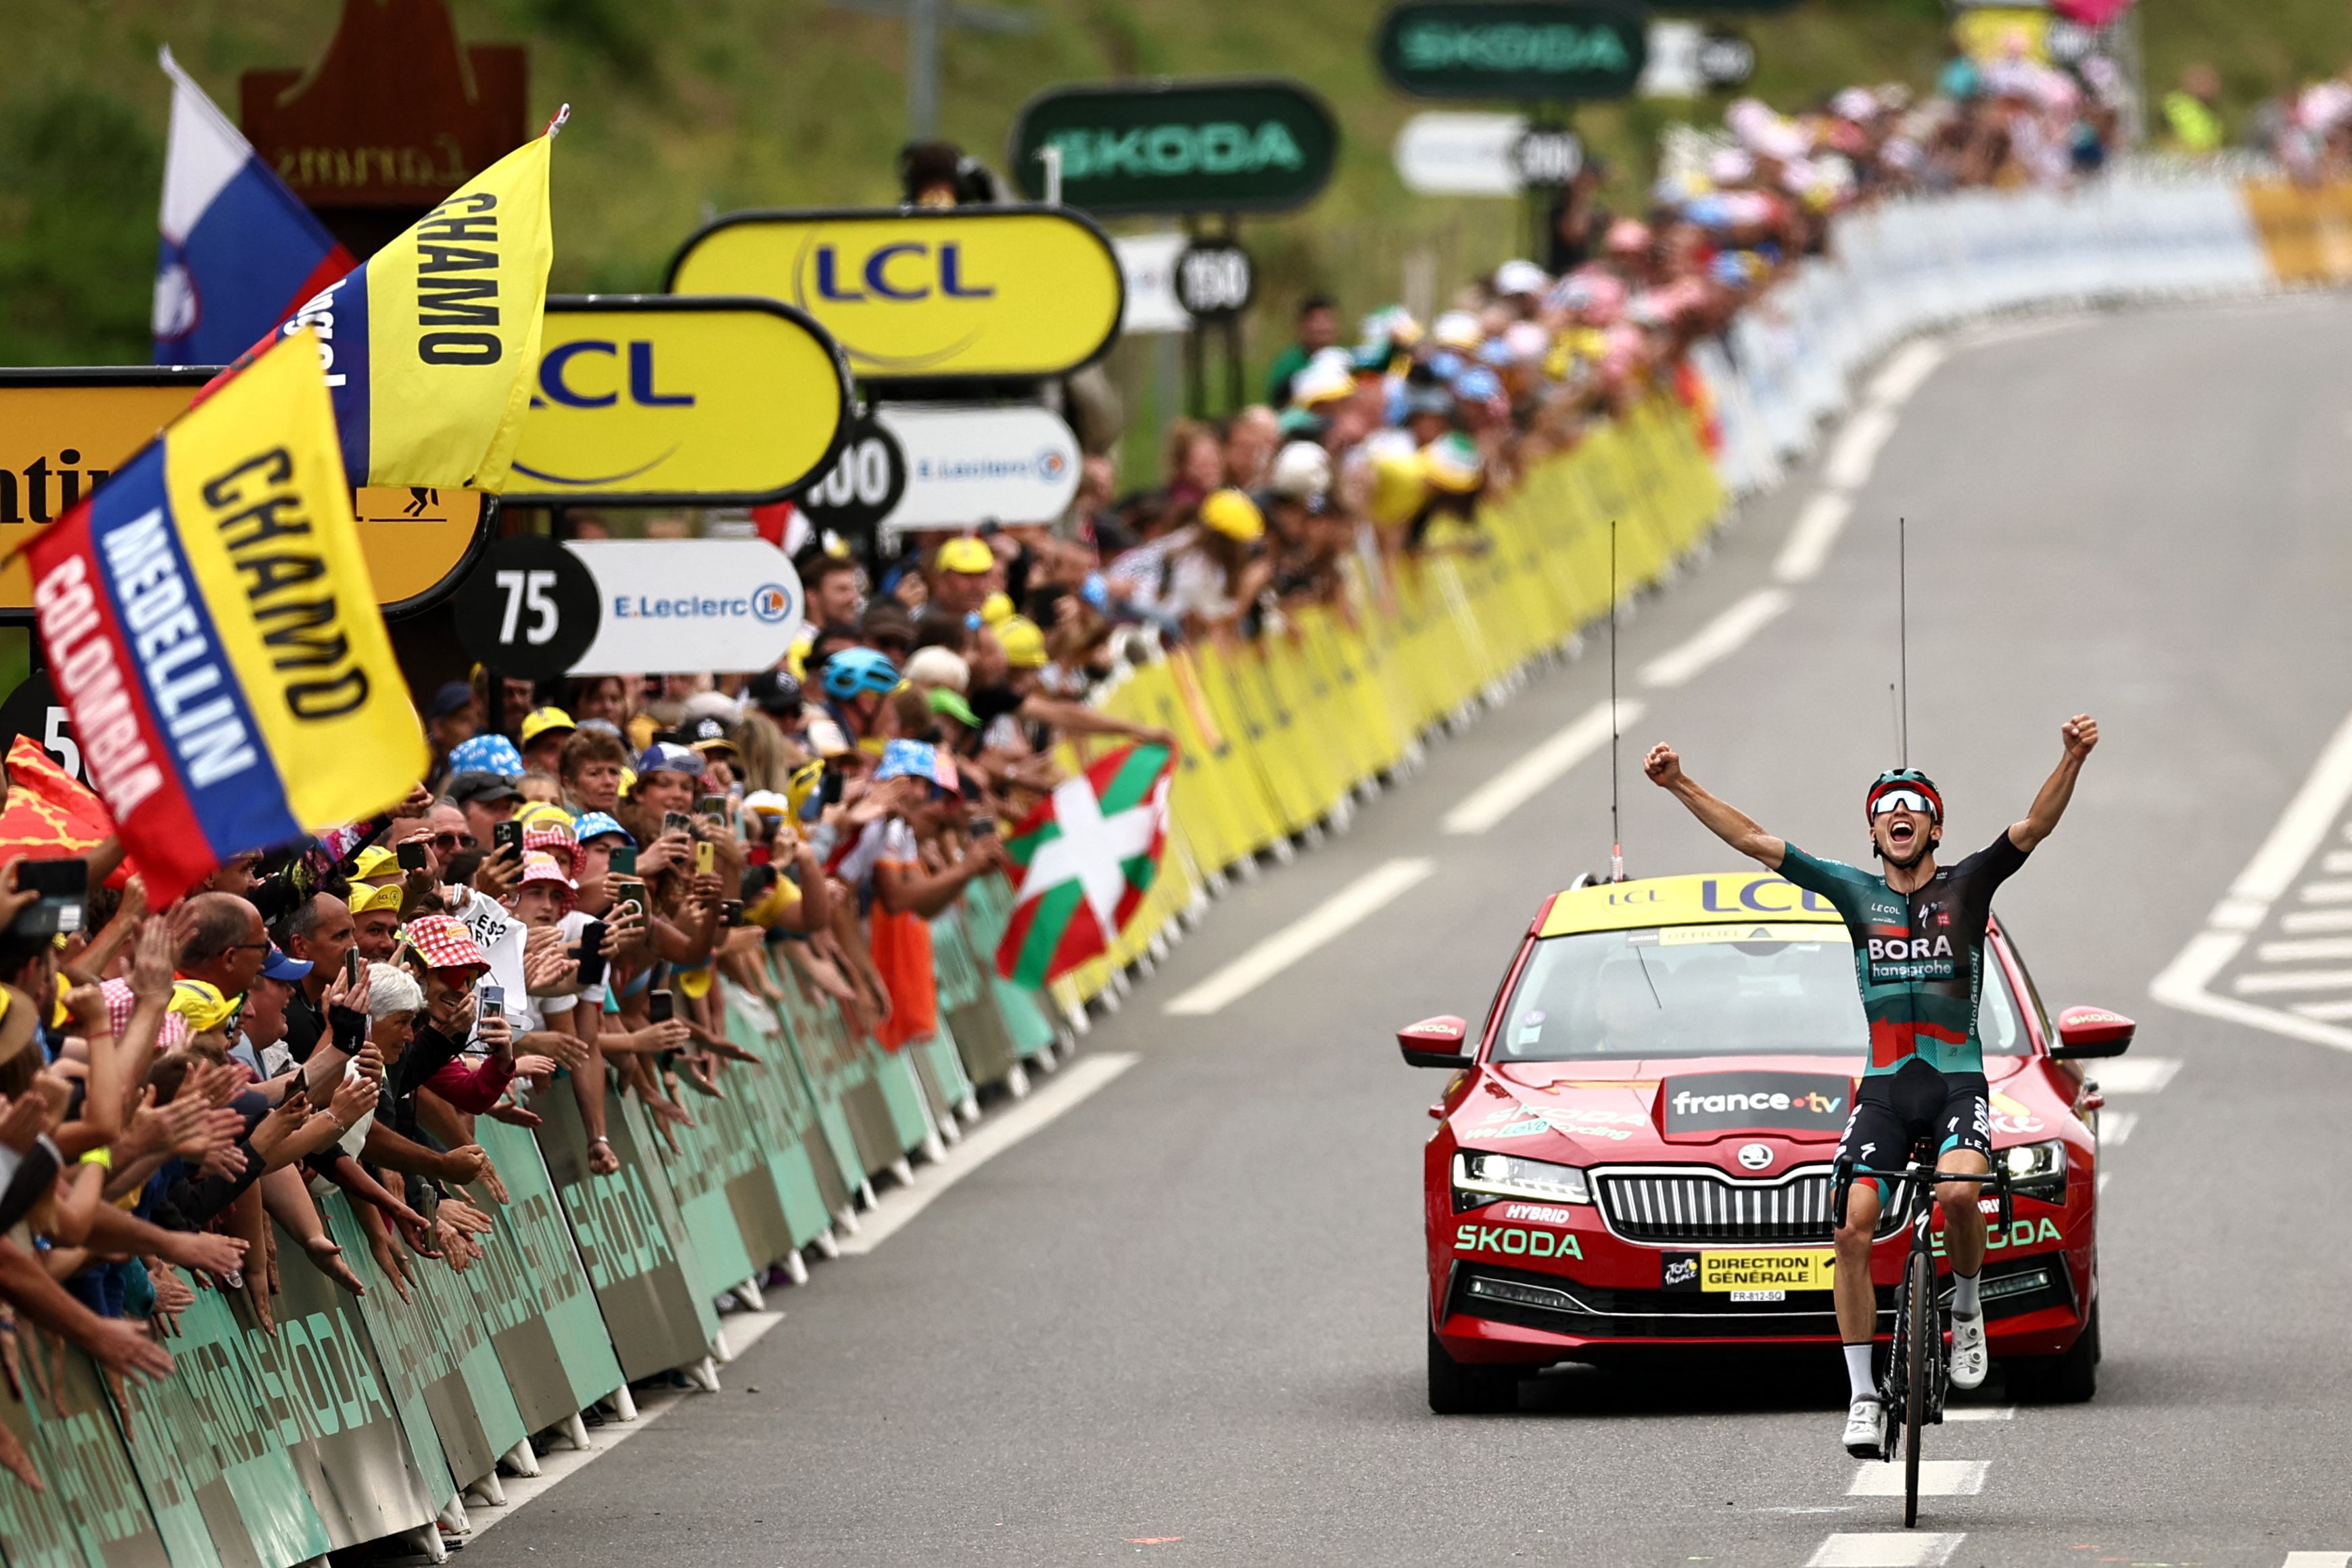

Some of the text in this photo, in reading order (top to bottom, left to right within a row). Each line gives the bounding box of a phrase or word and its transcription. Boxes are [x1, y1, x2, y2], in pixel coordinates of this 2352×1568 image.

[417, 192, 502, 366] CHAMO
[816, 241, 995, 303] LCL
[529, 340, 696, 410] CL
[807, 437, 891, 507] 00
[199, 445, 370, 723] CHAMO
[495, 569, 560, 645] 75
[614, 594, 749, 618] E.Leclerc
[102, 506, 258, 791] MEDELLIN
[34, 554, 162, 826] COLOMBIA
[44, 706, 101, 792] 5
[1608, 878, 1839, 912] LCL LCL
[1871, 903, 1900, 914] LE COL
[1667, 930, 1741, 939] OFFICIEL
[1868, 935, 1954, 960] BORA
[1873, 960, 1952, 977] hansgrohe
[1969, 951, 1980, 1037] hansgrohe
[1464, 1129, 1497, 1140] We
[1478, 1103, 1647, 1127] SKODA
[1965, 1138, 1982, 1149] LE
[563, 1162, 674, 1291] SKODA
[1506, 1204, 1570, 1224] HYBRID
[1454, 1225, 1584, 1260] SKODA
[1930, 1218, 2063, 1257] SODA
[1708, 1257, 1810, 1270] DIRECTION
[1708, 1269, 1810, 1284] GÉNÉRALE
[246, 1306, 392, 1447] SKODA
